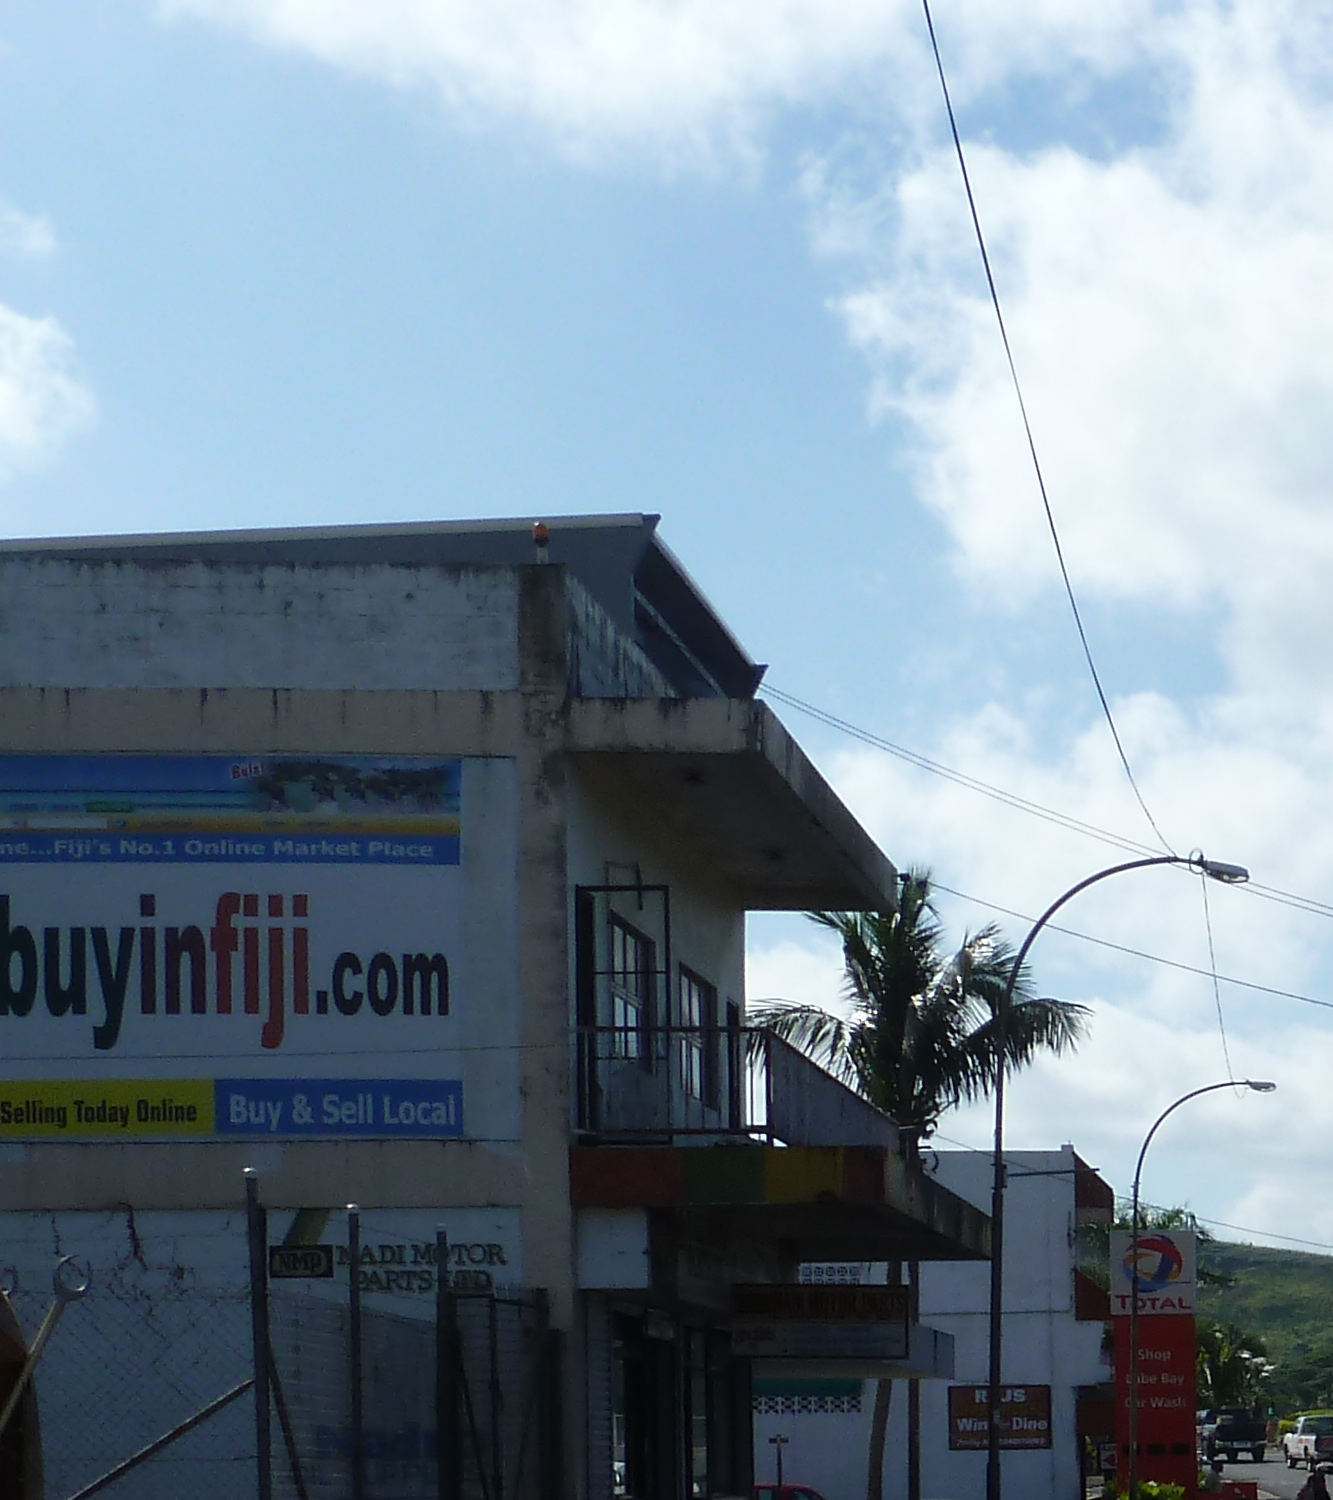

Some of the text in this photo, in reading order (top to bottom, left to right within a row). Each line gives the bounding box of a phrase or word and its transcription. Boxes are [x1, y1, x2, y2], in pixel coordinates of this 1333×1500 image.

[119, 839, 176, 855] No.1
[184, 838, 266, 856] Online
[273, 839, 361, 856] Market
[368, 841, 434, 858] Place
[0, 892, 450, 1050] buyinfiji.com
[0, 1099, 198, 1129] Selling Today Online
[229, 1094, 456, 1132] Buy & Sell Local
[1115, 1295, 1192, 1311] TOTAL
[1137, 1348, 1171, 1362] Shop
[1160, 1372, 1185, 1386] Bay
[974, 1389, 1027, 1404] RJS
[1150, 1396, 1186, 1408] Wash
[957, 1416, 1048, 1432] Win Dine
